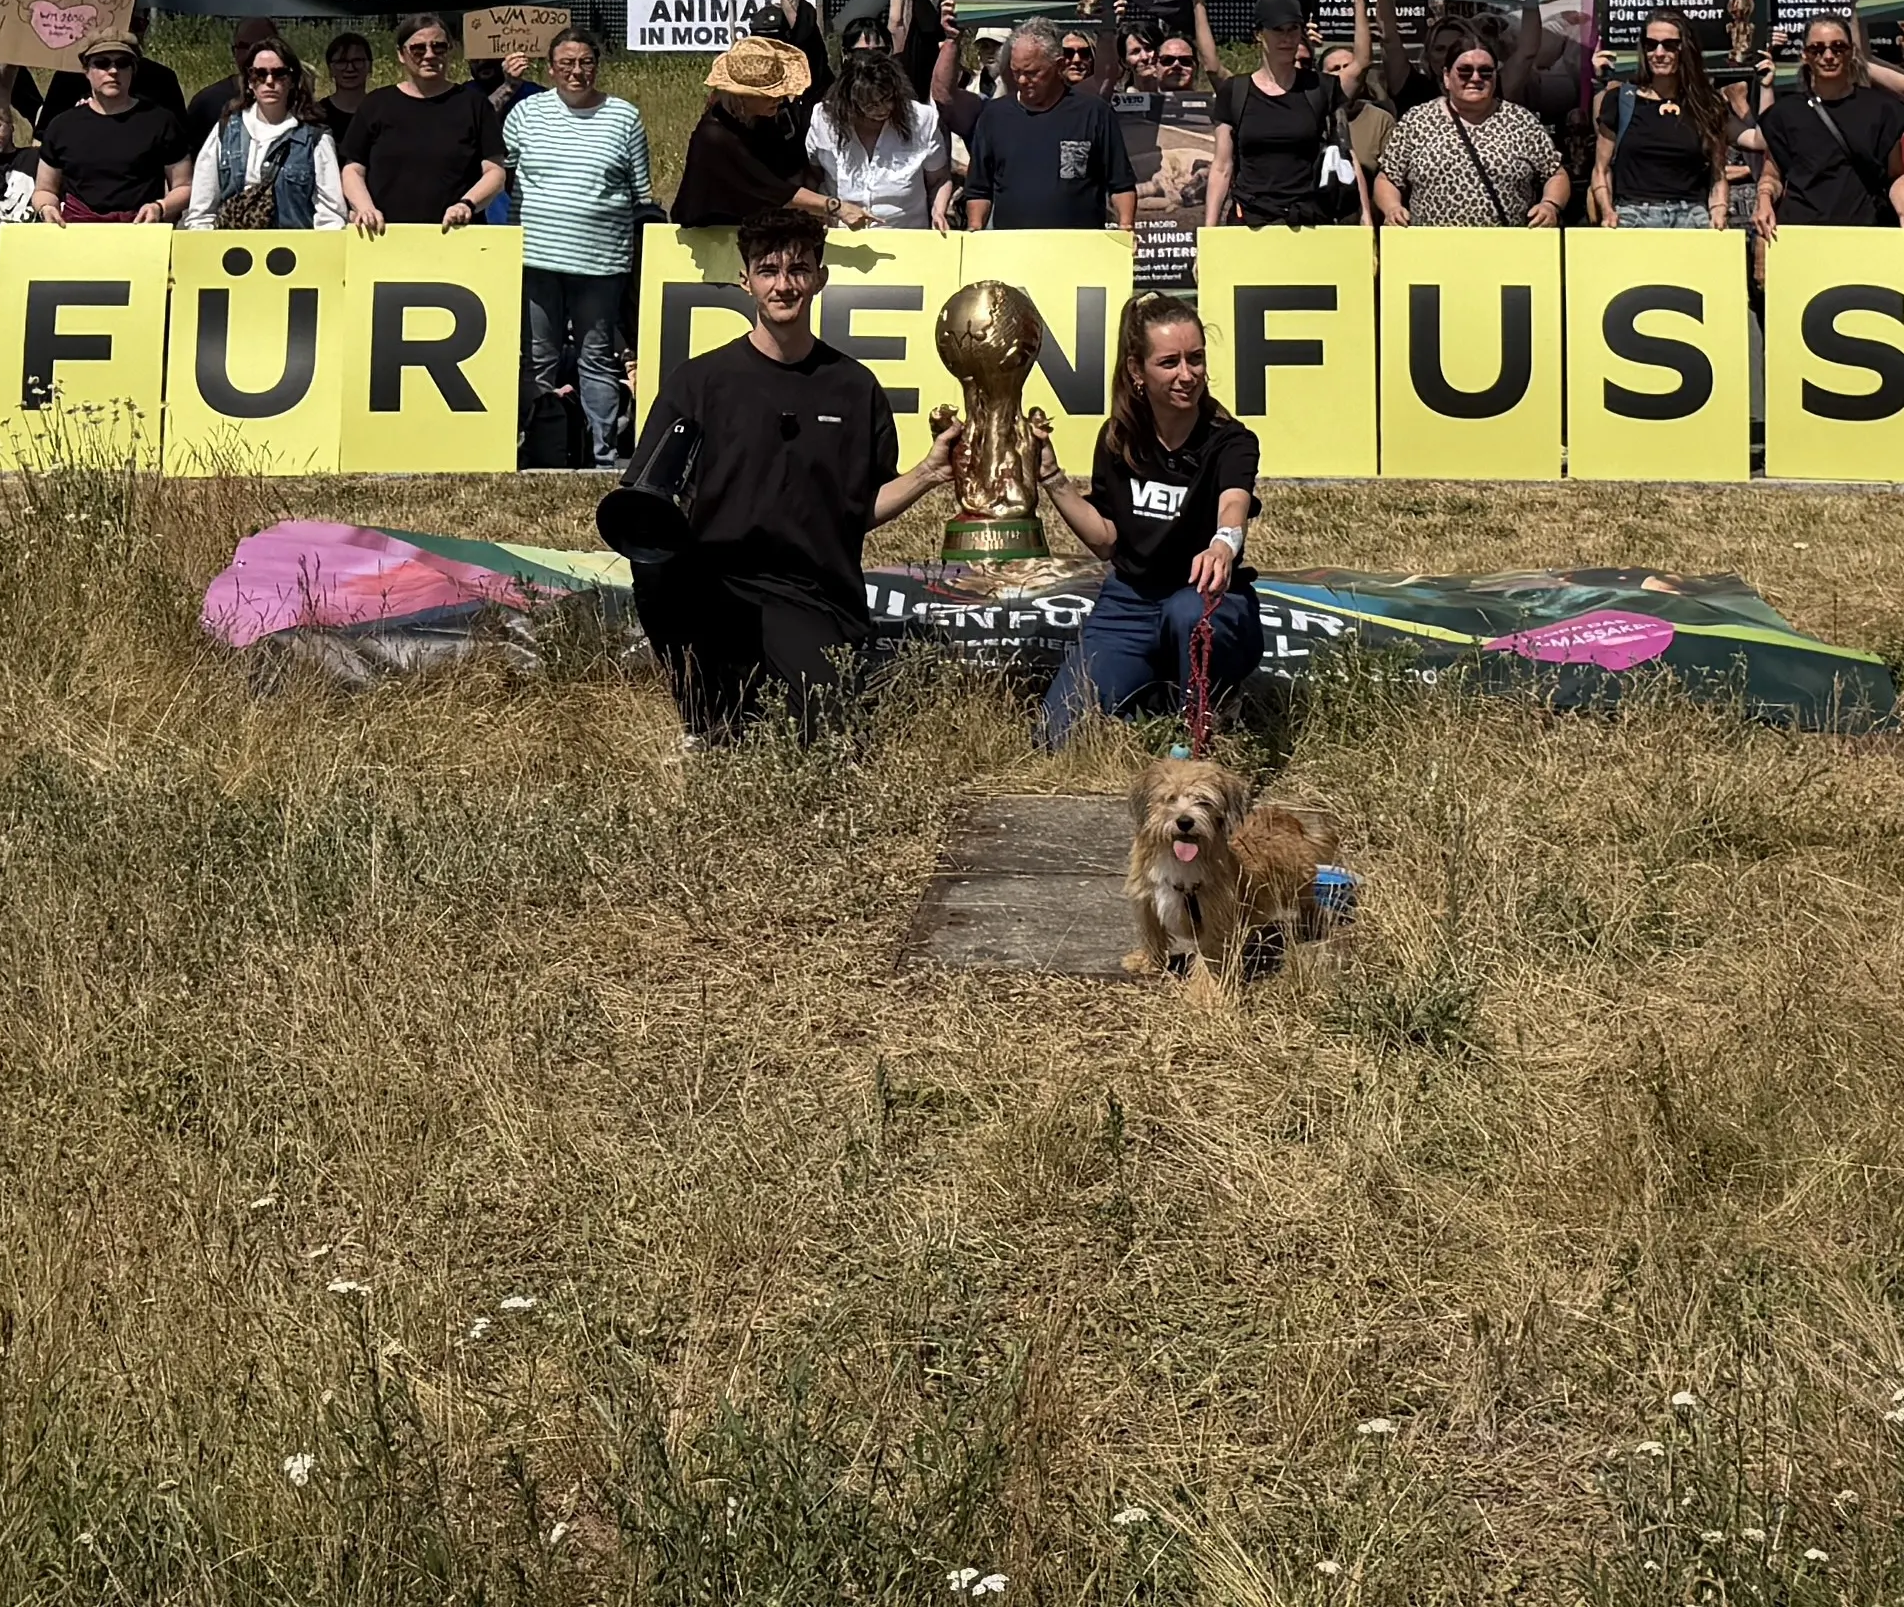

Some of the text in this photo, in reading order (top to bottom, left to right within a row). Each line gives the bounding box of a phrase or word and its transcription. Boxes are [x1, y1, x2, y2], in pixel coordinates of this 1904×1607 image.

[490, 6, 568, 26] WM 2030
[649, 0, 771, 22] ANIMA
[1609, 9, 1634, 21] FÜR
[640, 27, 664, 45] IN
[1148, 232, 1194, 243] HUNDE
[21, 247, 488, 419] FÜR
[1129, 477, 1188, 513] VET
